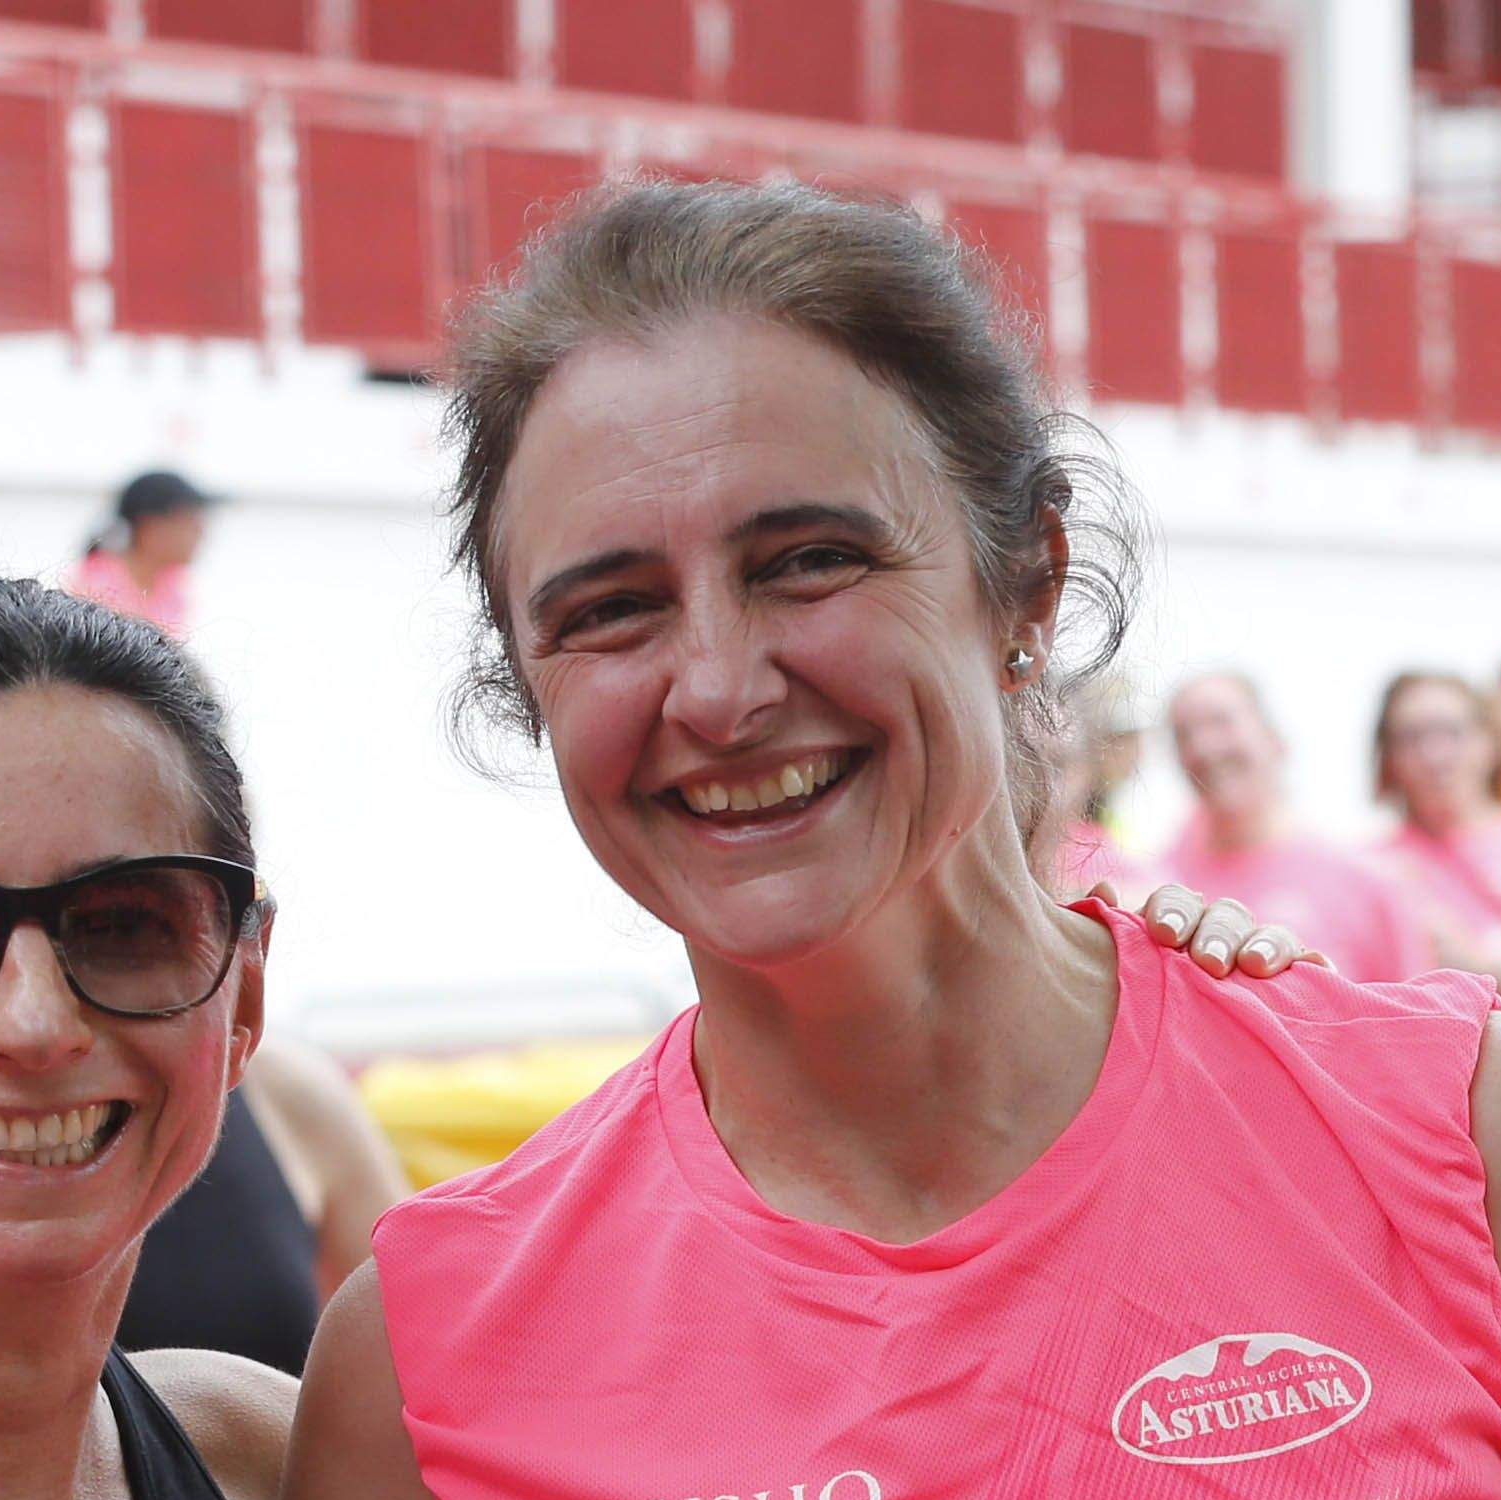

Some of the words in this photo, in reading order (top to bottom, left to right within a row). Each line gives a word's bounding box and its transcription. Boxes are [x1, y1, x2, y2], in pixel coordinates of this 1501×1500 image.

[1167, 1375, 1252, 1403] CENTRAL
[1257, 1360, 1338, 1386] LECHERA
[1139, 1376, 1356, 1449] ASTURIANA
